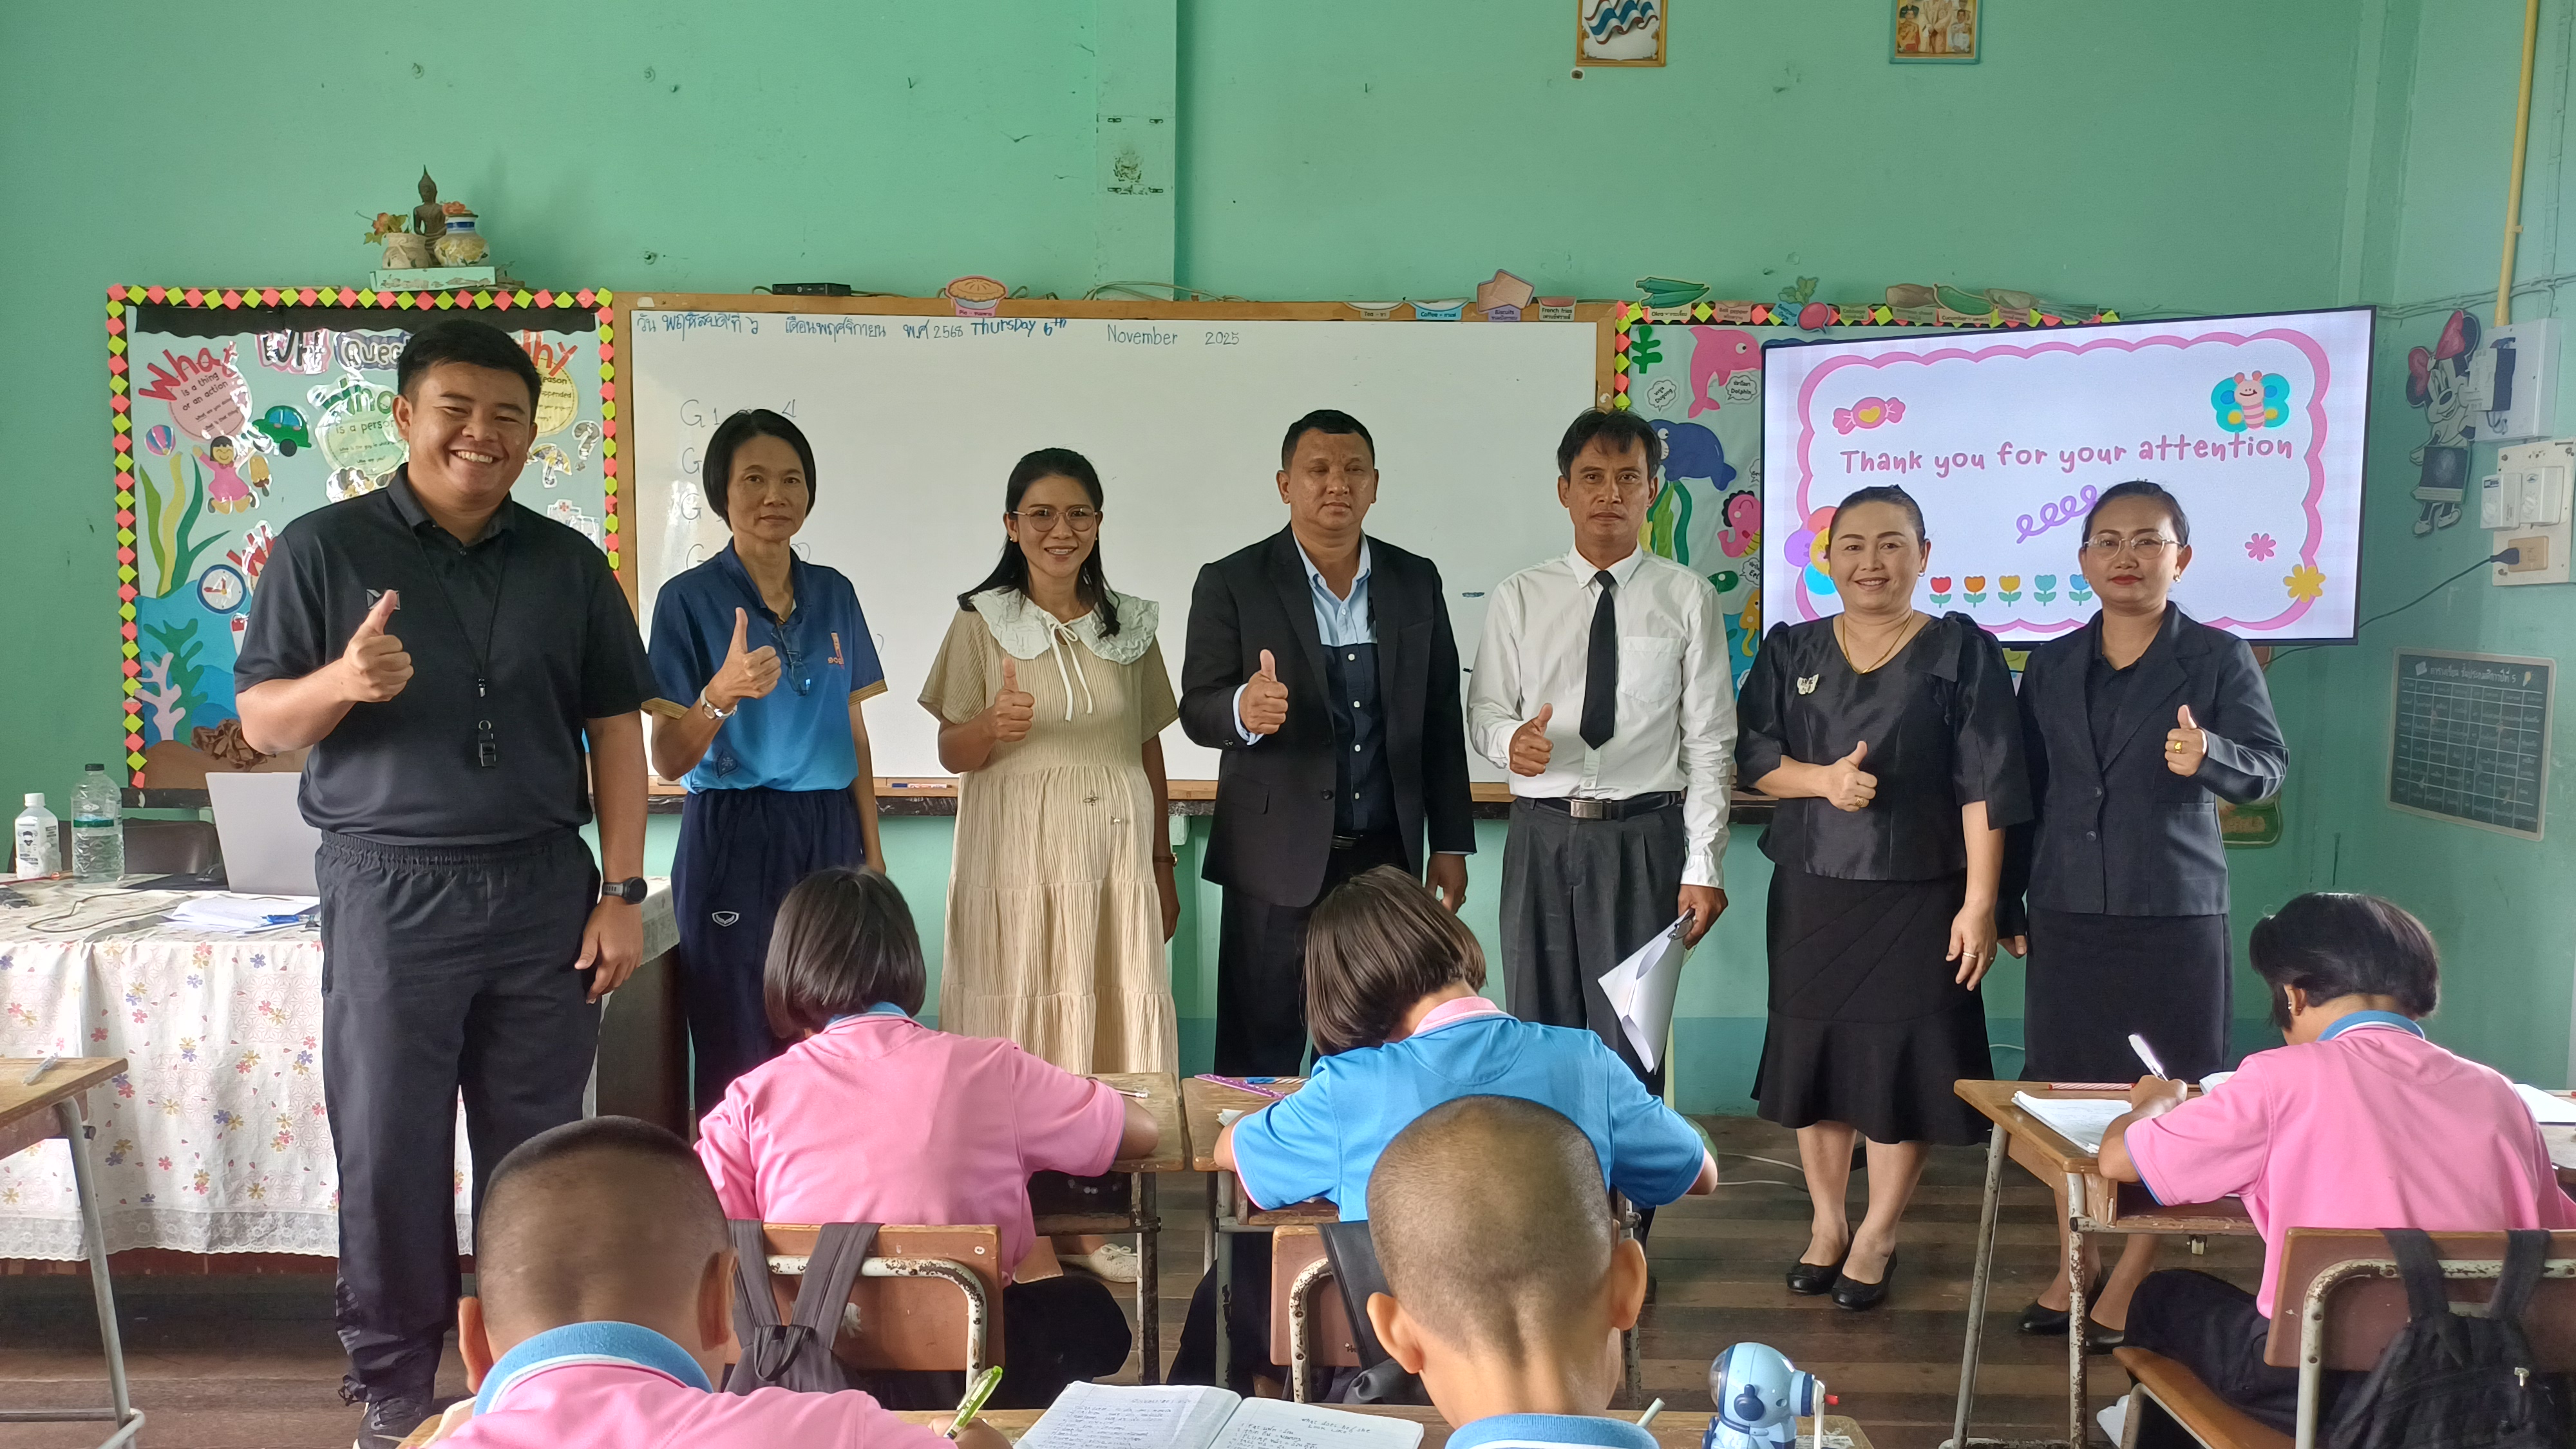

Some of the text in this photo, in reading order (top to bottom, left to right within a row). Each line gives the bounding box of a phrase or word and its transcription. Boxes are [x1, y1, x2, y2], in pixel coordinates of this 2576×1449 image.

[637, 313, 656, 333] วัน
[933, 325, 963, 339] 2568
[1107, 323, 1240, 345] November 2025
[138, 340, 239, 401] What
[542, 376, 567, 385] eason
[181, 388, 190, 397] is
[197, 372, 220, 386] thing
[182, 380, 229, 411] or an action
[1654, 388, 1674, 404] Dugong
[336, 423, 345, 434] is
[681, 447, 703, 474] G
[1840, 432, 2293, 478] Thank you for your attention
[681, 493, 701, 520] G
